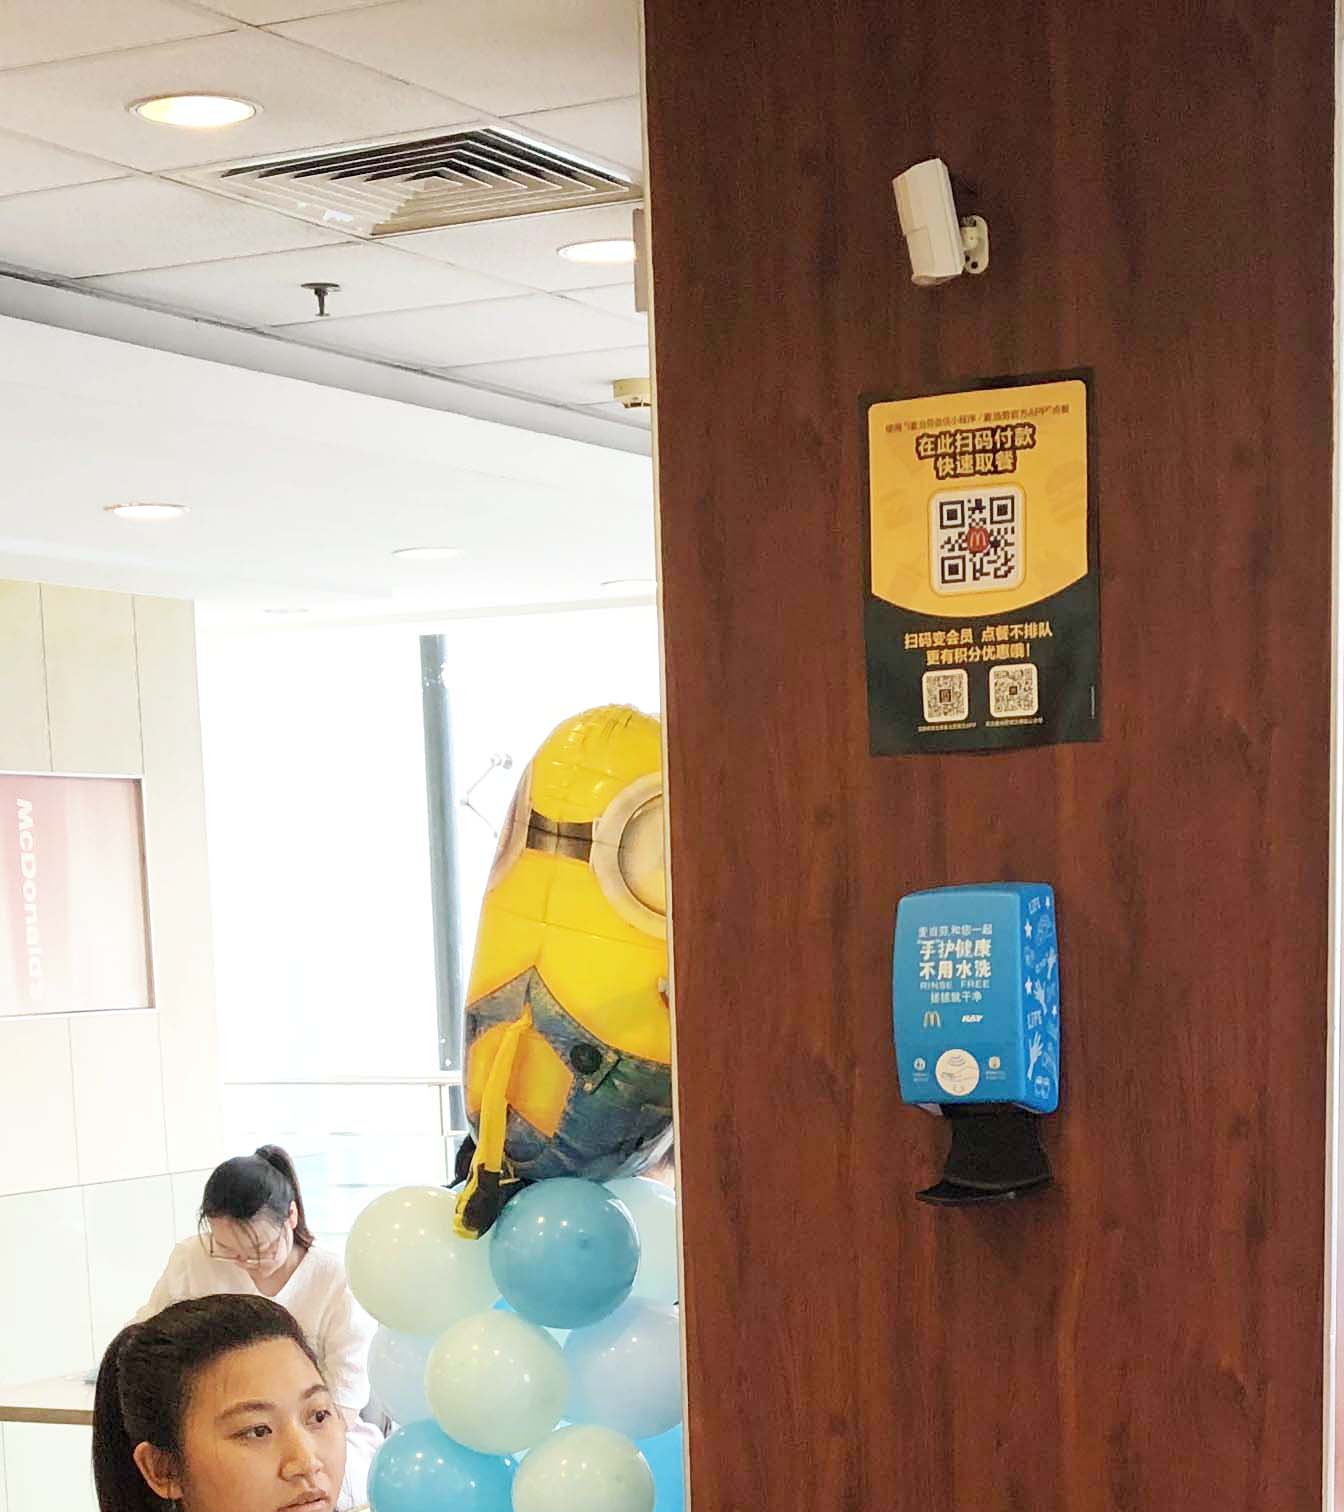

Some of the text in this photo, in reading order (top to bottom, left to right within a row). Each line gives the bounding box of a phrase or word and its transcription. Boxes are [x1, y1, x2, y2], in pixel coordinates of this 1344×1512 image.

[917, 425, 1035, 457] 在此扫码付款
[936, 450, 1016, 478] 快速取餐
[904, 621, 1054, 649] 扫码变会员 点餐不排队
[919, 959, 992, 980] 不用水洗
[920, 979, 990, 990] RINSE FREE
